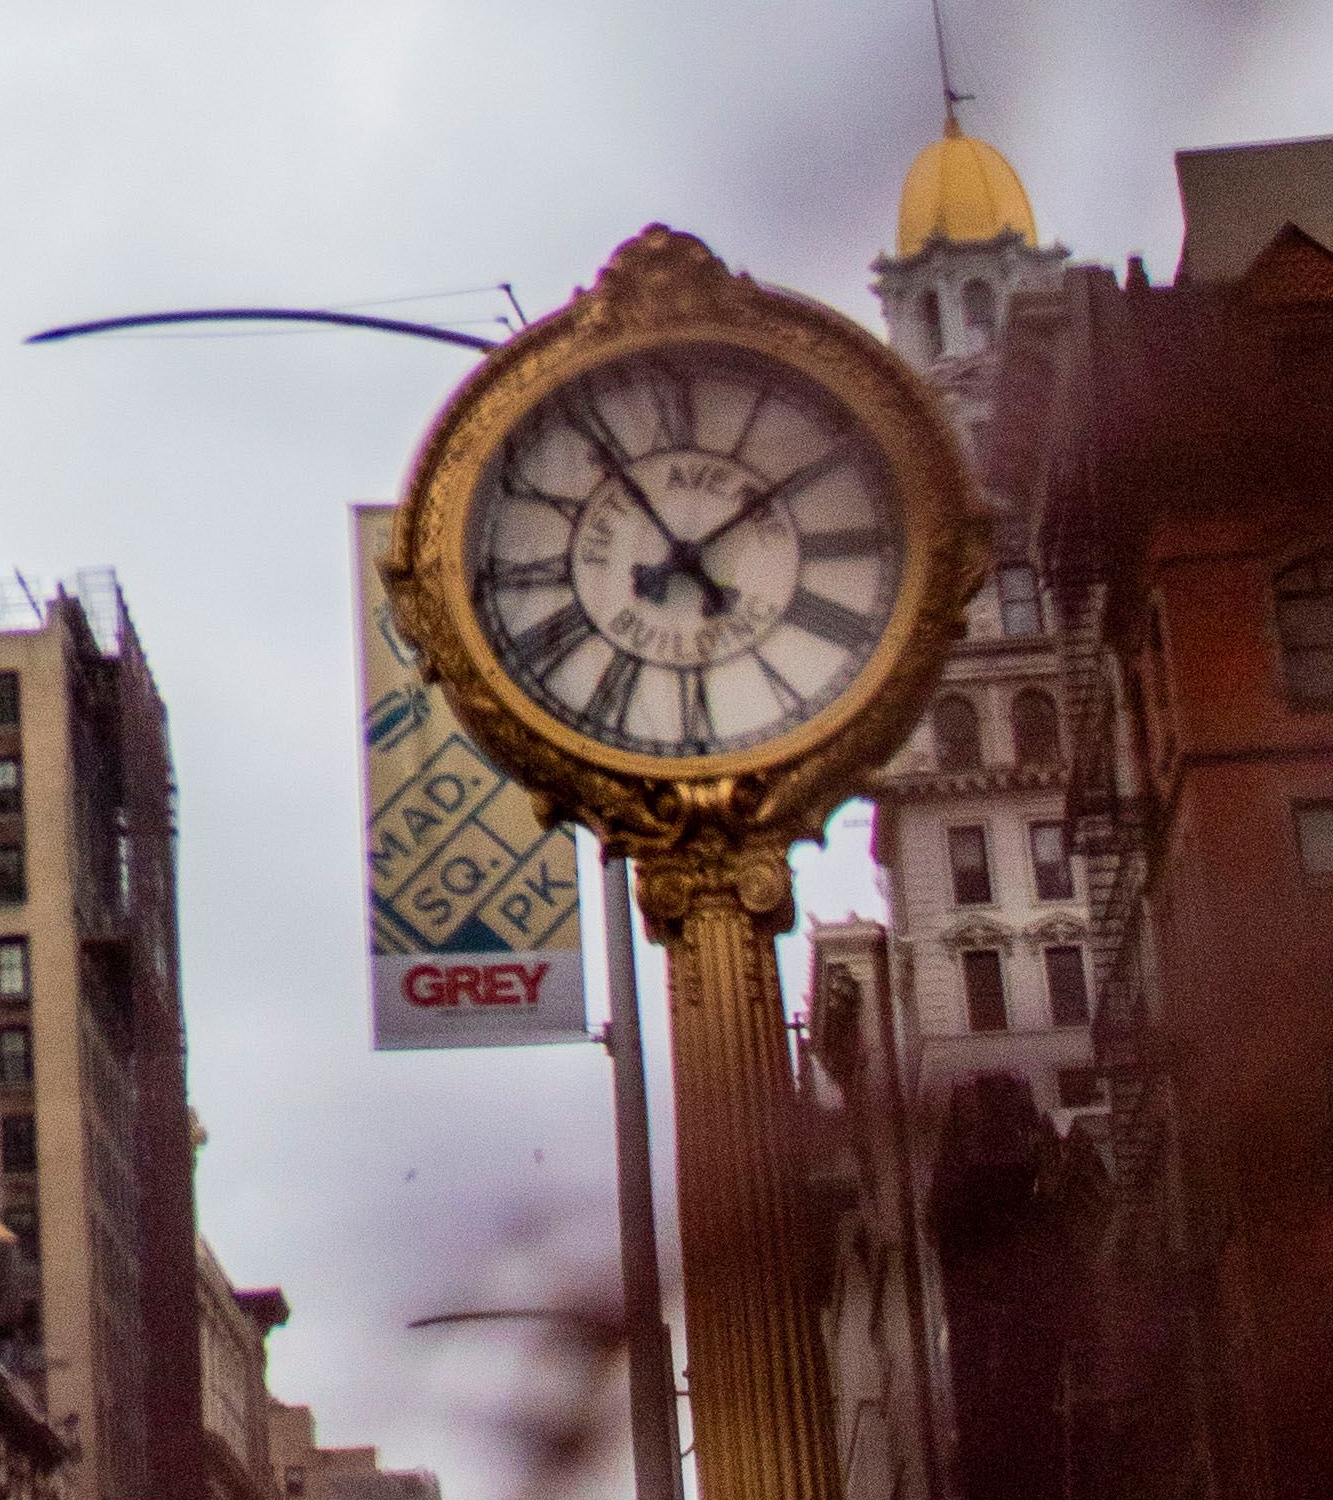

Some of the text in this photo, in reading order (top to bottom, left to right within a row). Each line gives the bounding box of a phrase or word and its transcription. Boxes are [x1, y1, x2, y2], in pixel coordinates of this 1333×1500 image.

[415, 855, 501, 926] SQ.
[499, 861, 574, 935] PK
[400, 961, 550, 1008] GREY
